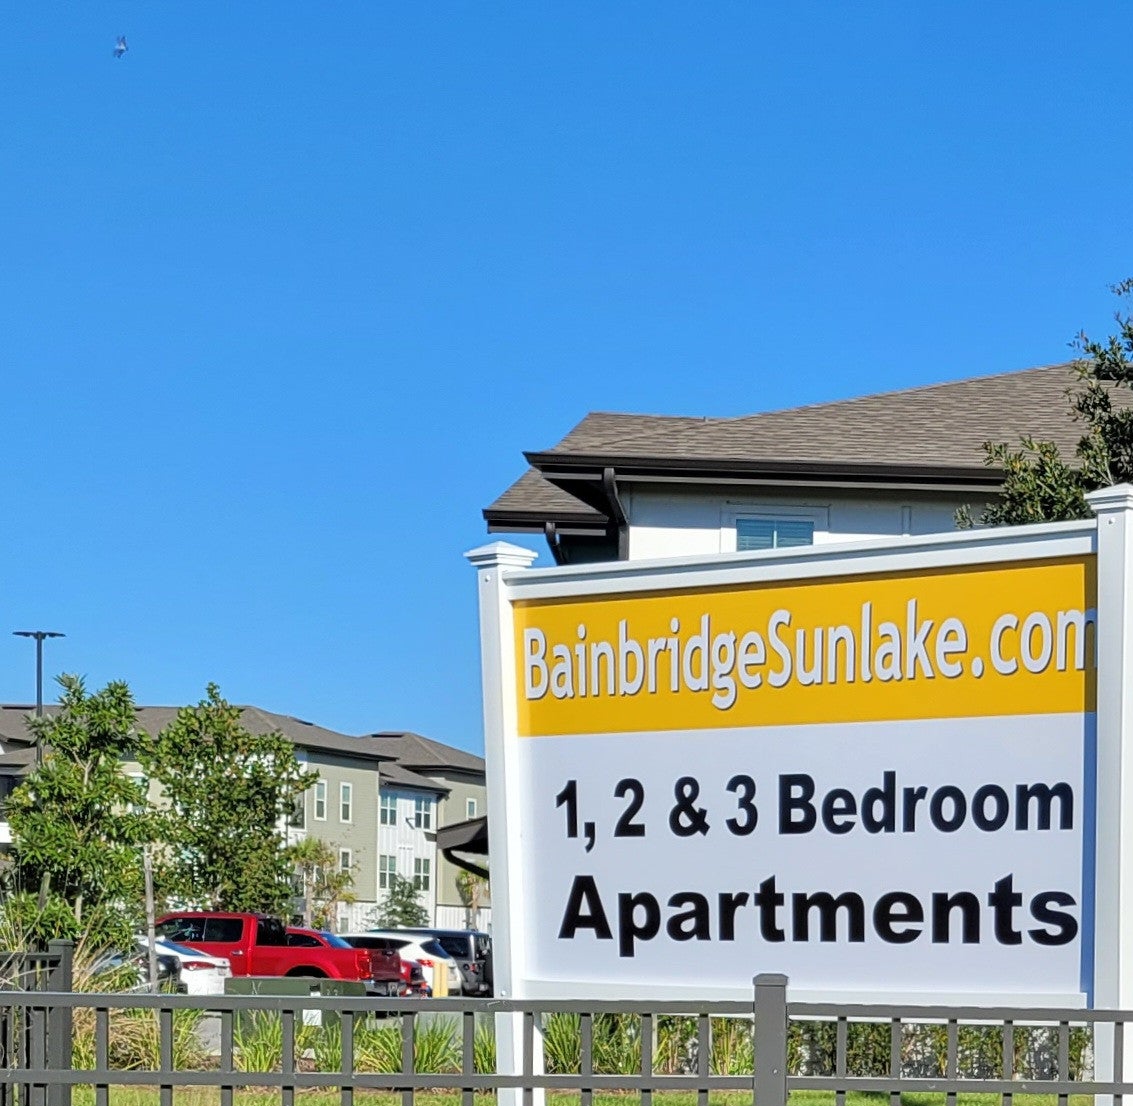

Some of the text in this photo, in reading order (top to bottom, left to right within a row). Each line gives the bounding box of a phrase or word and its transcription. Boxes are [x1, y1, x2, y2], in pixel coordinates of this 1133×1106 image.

[523, 599, 1097, 710] BainbridgeSunlake.com
[556, 770, 1073, 853] 1, 2 & 3 Bedroom
[558, 873, 1078, 957] Apartments
